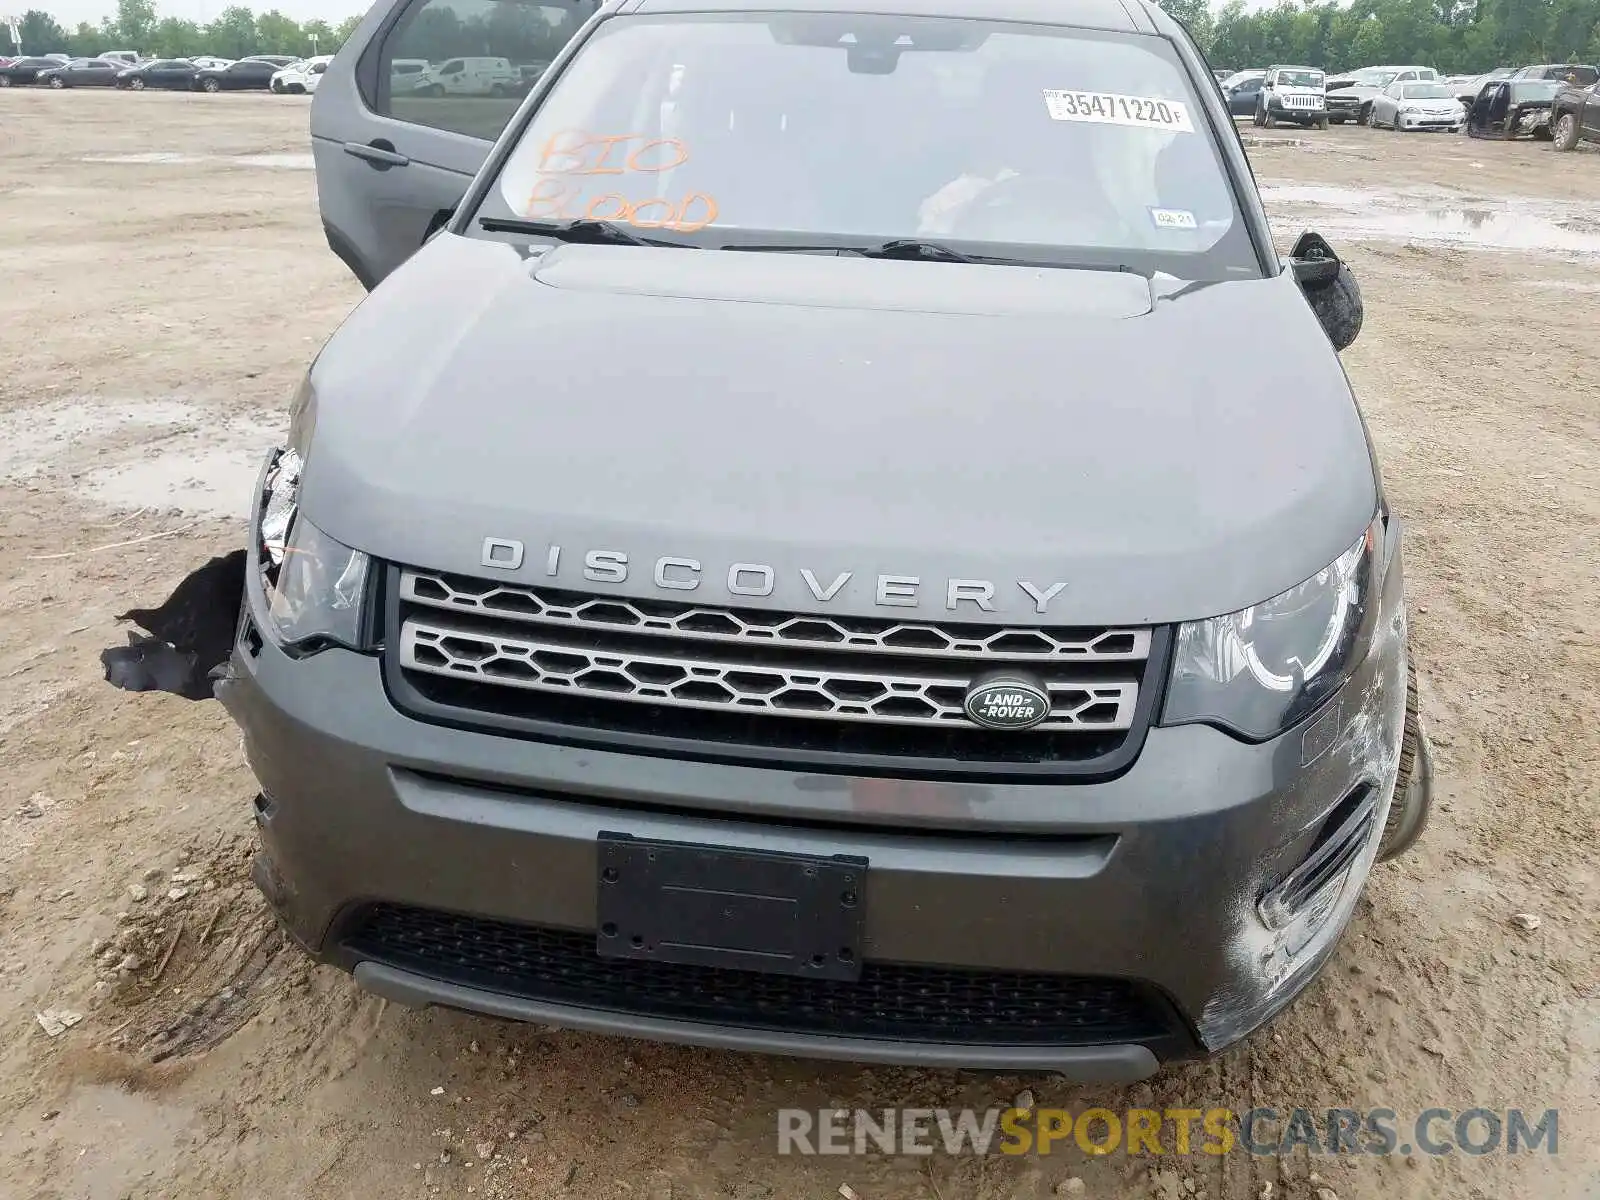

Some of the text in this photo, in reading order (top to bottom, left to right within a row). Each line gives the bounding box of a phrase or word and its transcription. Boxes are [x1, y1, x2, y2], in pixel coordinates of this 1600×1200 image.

[536, 131, 689, 175] BIO
[526, 179, 719, 235] BLOOD
[480, 536, 1069, 614] DISCOVERY
[983, 693, 1024, 706] LAND
[986, 705, 1035, 719] ROVER
